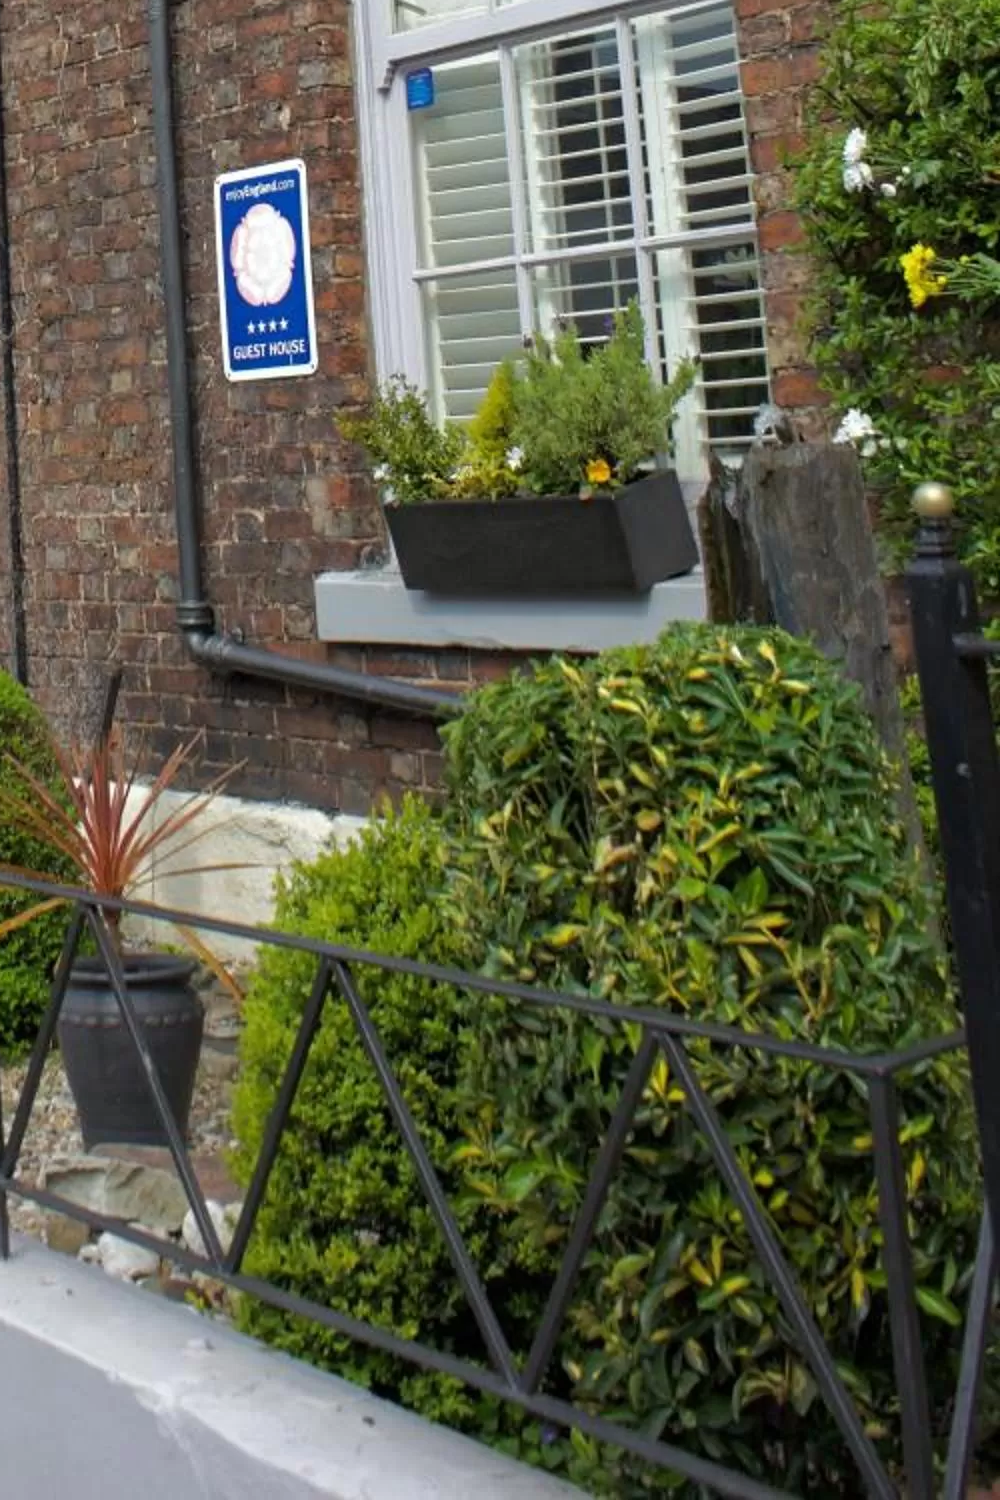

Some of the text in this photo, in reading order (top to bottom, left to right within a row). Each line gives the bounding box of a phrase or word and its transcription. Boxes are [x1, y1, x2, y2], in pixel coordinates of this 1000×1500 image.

[225, 179, 295, 201] enjoyEngland.com
[233, 339, 306, 360] GUEST HOUSE
